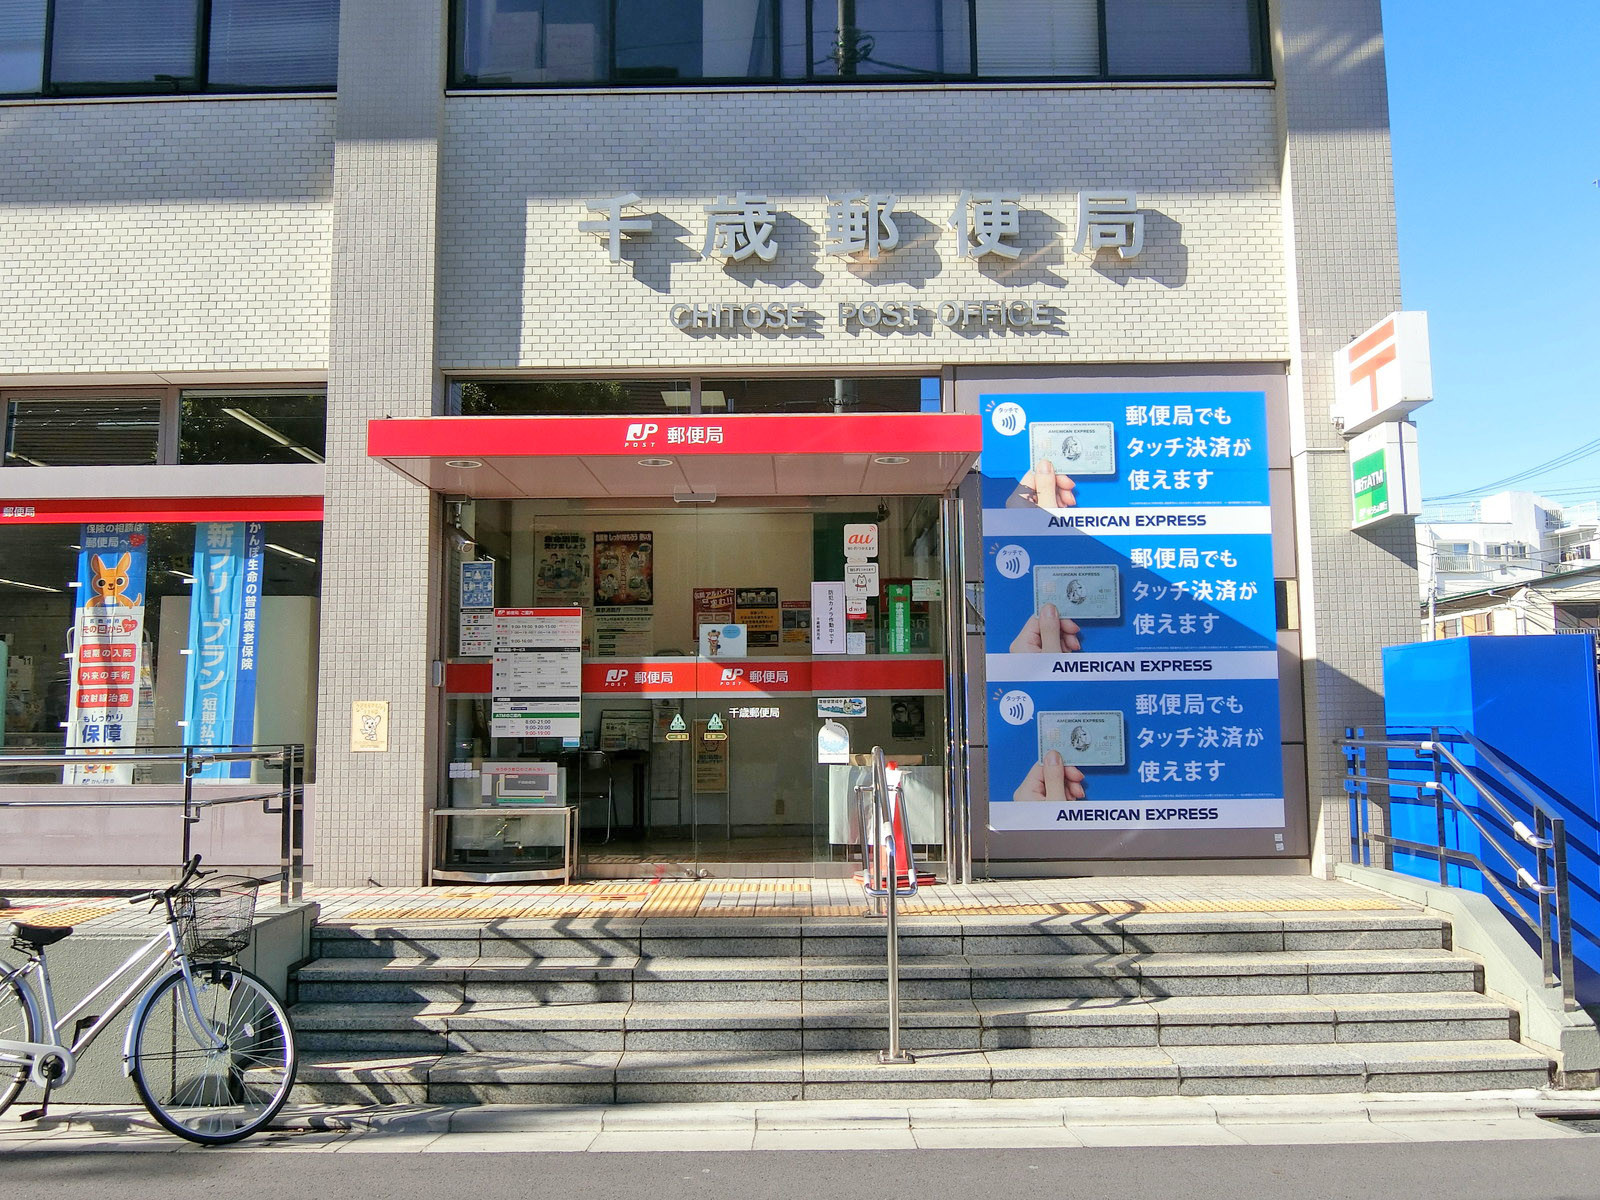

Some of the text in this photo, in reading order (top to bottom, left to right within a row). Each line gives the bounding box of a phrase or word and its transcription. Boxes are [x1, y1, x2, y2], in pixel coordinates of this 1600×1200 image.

[578, 191, 1144, 263] 千歳郵便局
[668, 300, 1053, 329] CHITOSE POST OFFICE
[1125, 404, 1232, 426] 郵便局でも
[668, 426, 724, 444] 郵便局
[1127, 436, 1252, 458] タッチ決済が
[1128, 468, 1214, 491] 使えます
[3, 506, 35, 517] 郵便局
[1048, 514, 1207, 528] AMERICAN EXPRESS
[85, 536, 129, 548] 郵便局へ
[848, 533, 874, 545] au
[1130, 547, 1238, 569] 郵便局でも
[241, 522, 262, 671] かんぽ生命の普通養老保険
[1132, 579, 1258, 602] タッチ決済が
[1133, 613, 1220, 635] 使えます
[82, 671, 130, 680] 外来の手術
[1052, 659, 1213, 673] AMERICAN EXPRESS
[634, 671, 673, 684] 郵便局
[749, 670, 788, 683] 郵便局
[729, 707, 780, 718] 千歳郵便局
[1135, 693, 1244, 715] 郵便局でも
[83, 713, 124, 723] もしっかり
[82, 724, 122, 743] 保障
[1136, 726, 1264, 749] タッチ決済が
[1138, 760, 1226, 783] 使えます
[1056, 808, 1219, 822] AMERICAN EXPRESS
